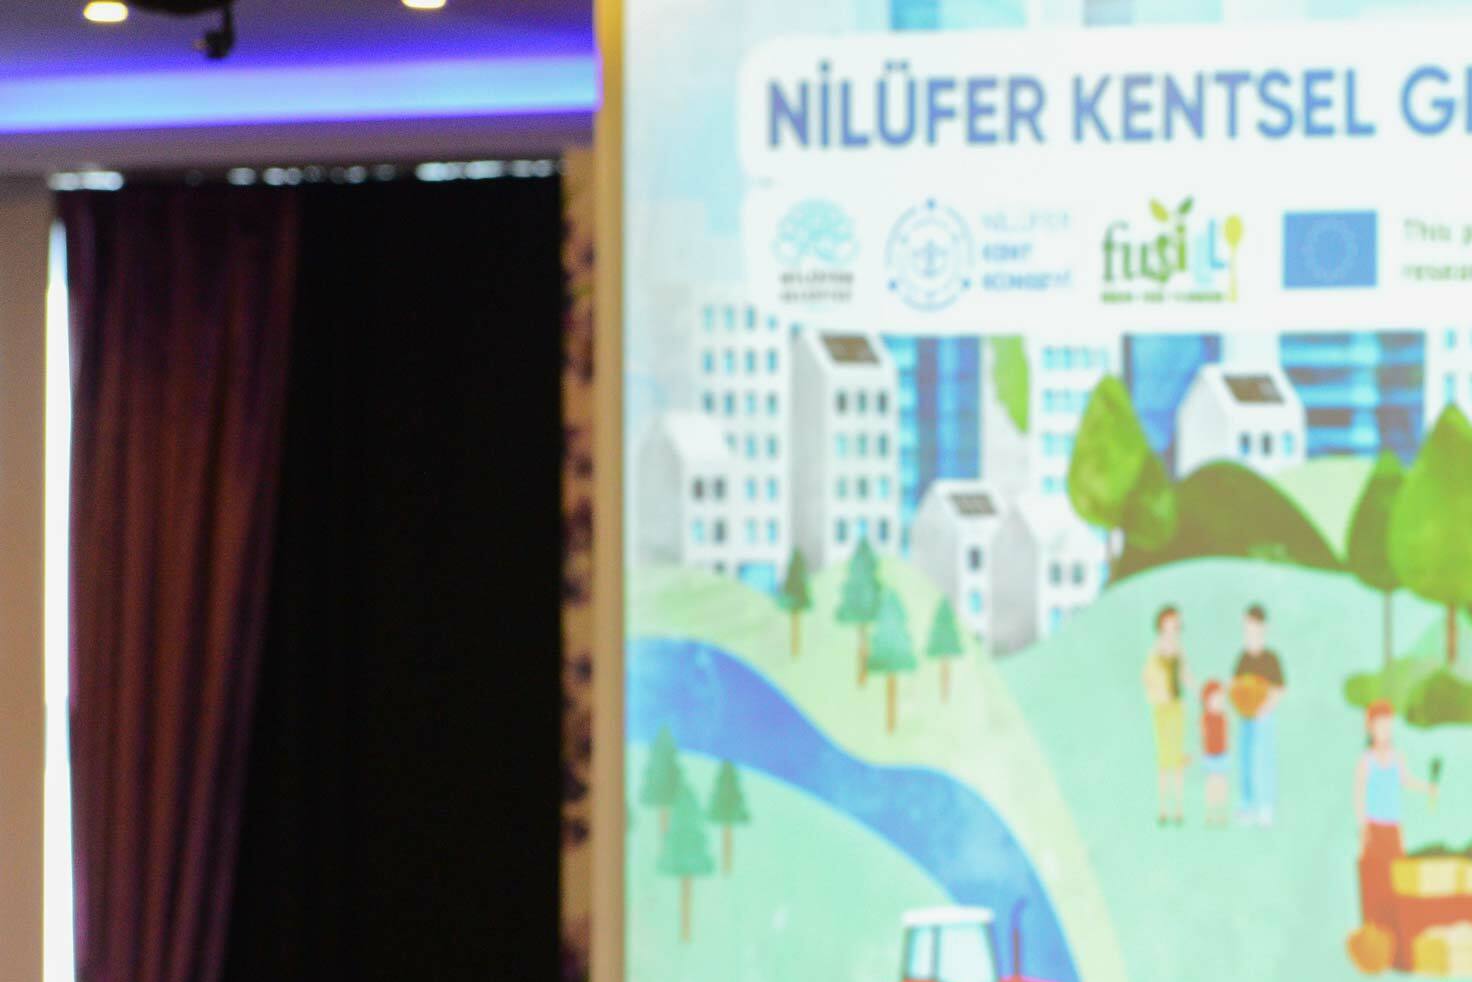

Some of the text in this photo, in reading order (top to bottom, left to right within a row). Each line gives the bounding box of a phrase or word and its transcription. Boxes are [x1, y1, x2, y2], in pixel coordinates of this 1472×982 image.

[767, 59, 1047, 151] NİLÜFER
[1071, 68, 1378, 144] KENTSEL
[1404, 216, 1451, 243] This
